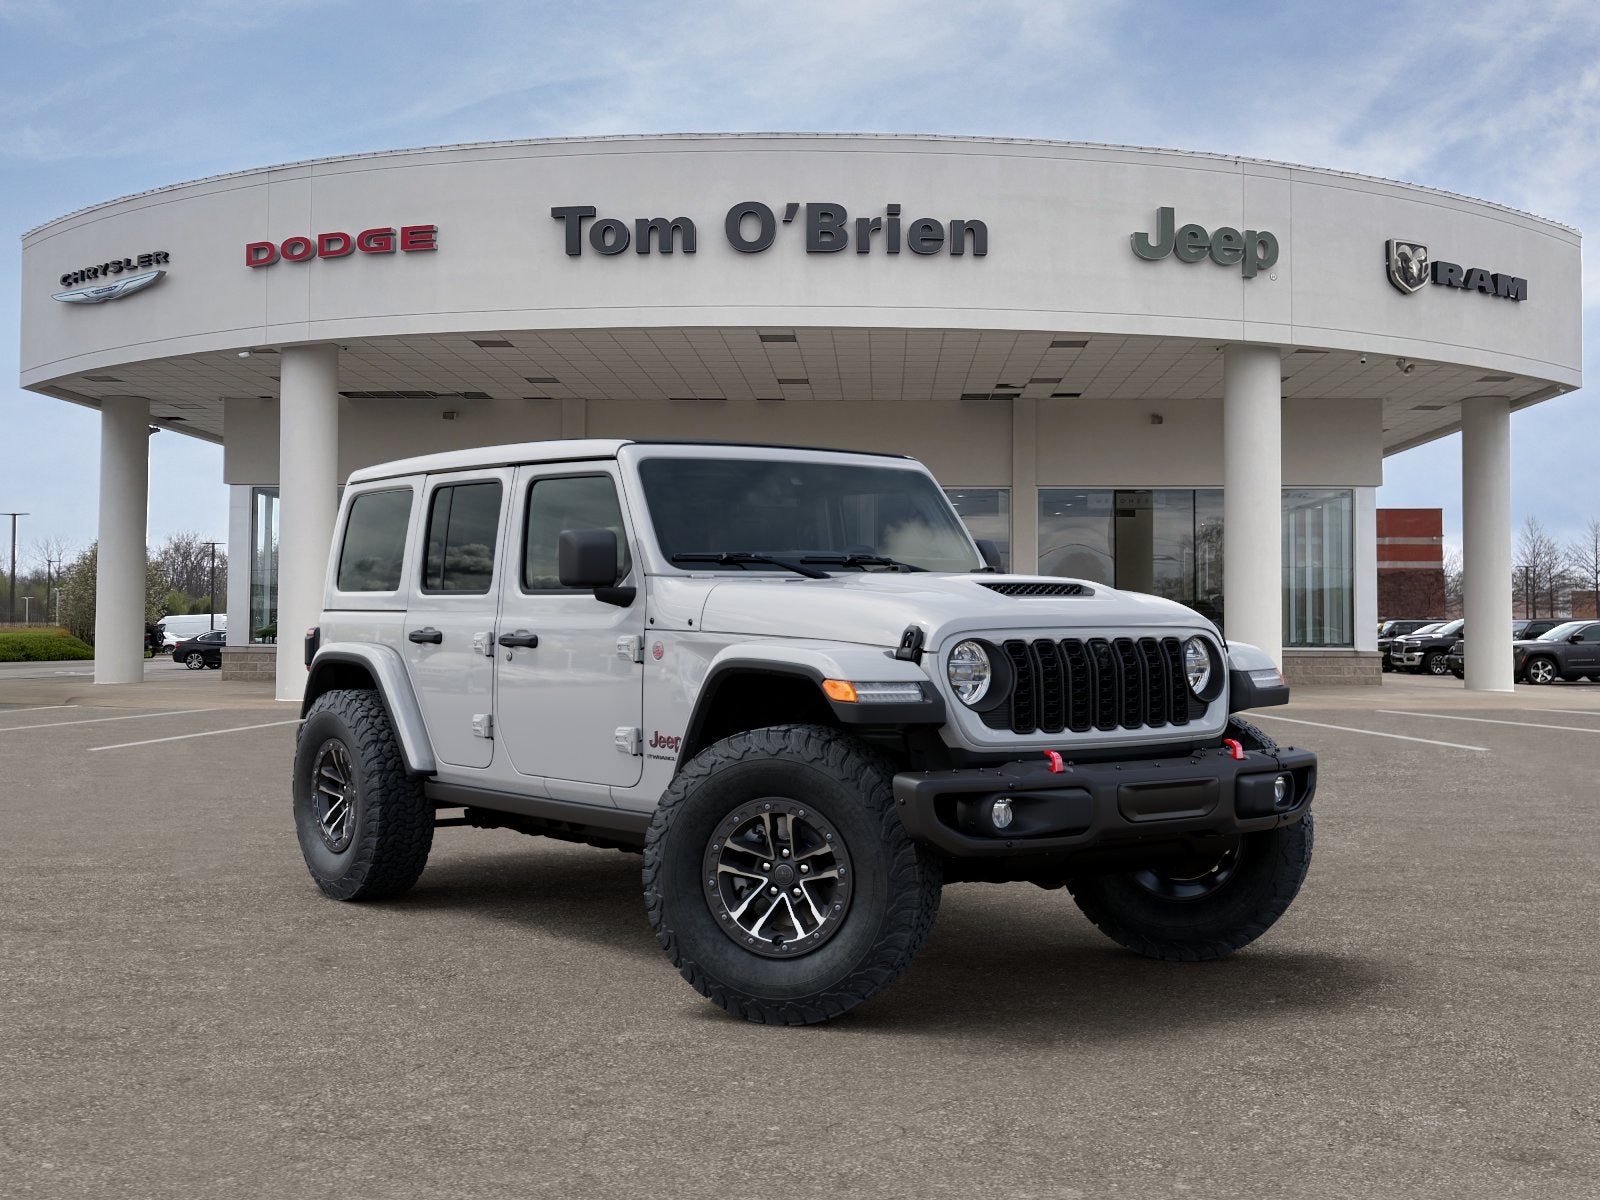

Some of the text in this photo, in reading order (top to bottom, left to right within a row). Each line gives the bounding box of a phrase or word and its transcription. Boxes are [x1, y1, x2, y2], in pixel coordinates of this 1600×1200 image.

[245, 224, 438, 268] DODGE
[551, 201, 989, 257] Tom O'Brien
[1131, 206, 1280, 279] Jeep
[59, 250, 170, 287] CHRYSLER
[1430, 260, 1528, 301] RAM
